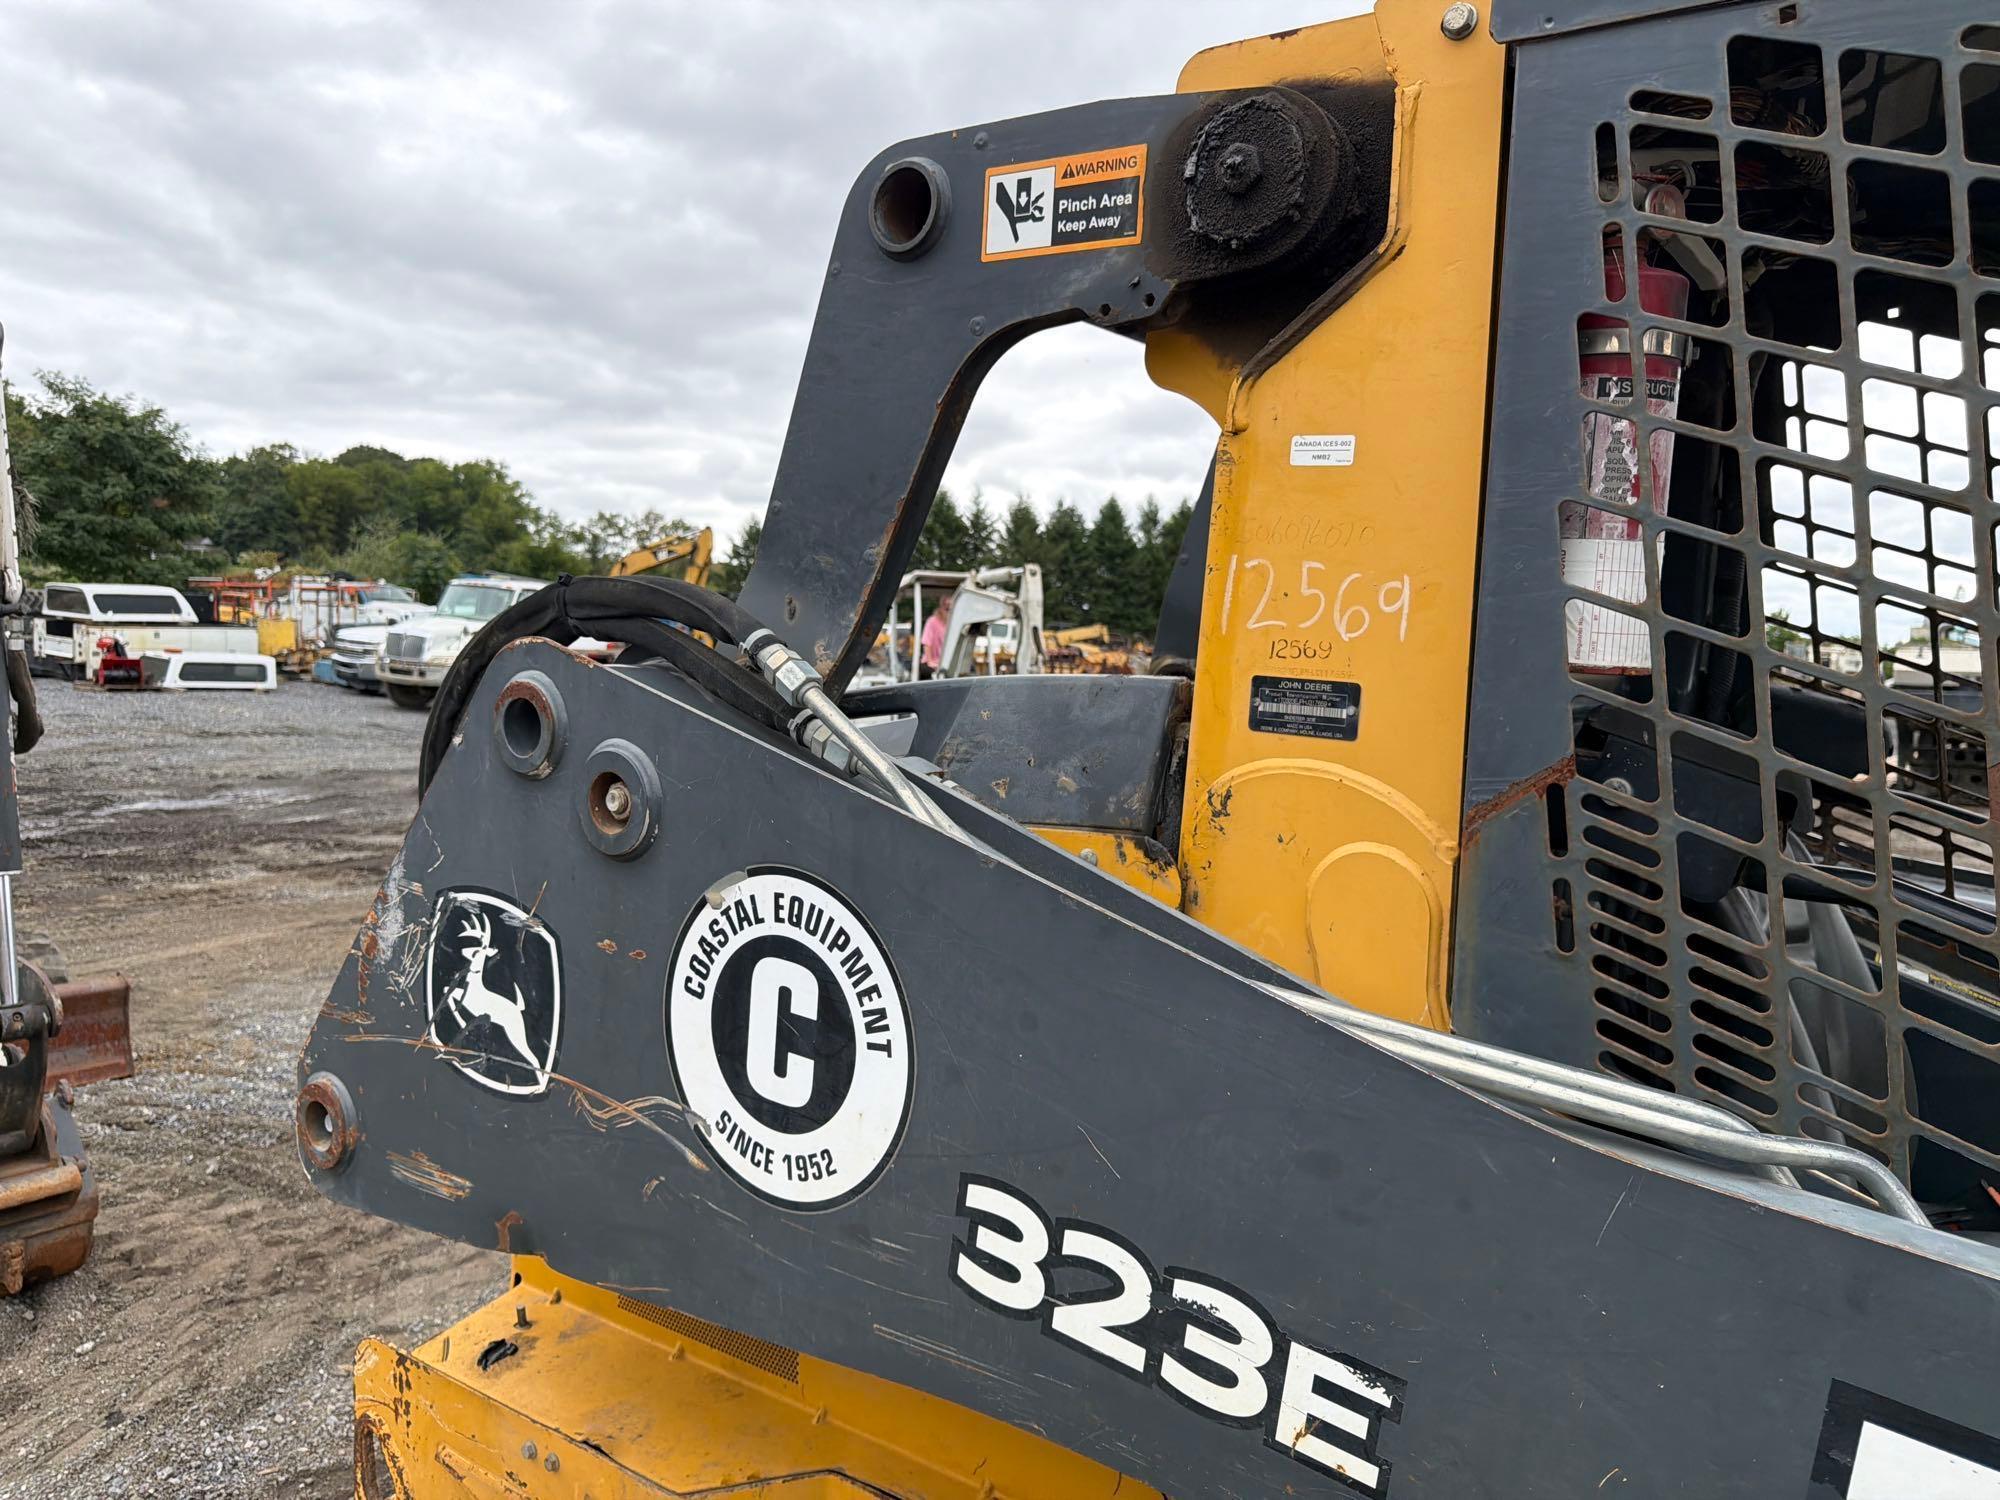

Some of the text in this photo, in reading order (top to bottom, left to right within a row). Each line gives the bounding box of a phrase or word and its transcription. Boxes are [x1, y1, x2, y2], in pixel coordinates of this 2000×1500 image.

[1075, 156, 1138, 176] WARNING
[1057, 215, 1121, 234] Keep Away
[1058, 192, 1133, 214] Pinch Area
[1222, 554, 1411, 642] 12569
[1269, 638, 1333, 660] 12569
[1278, 680, 1333, 692] JOHN DEERE
[684, 892, 892, 1058] COASTAL EQUIPMENT
[746, 956, 819, 1108] C
[715, 1109, 838, 1182] SINCE 1952
[956, 1183, 1393, 1490] 323E
